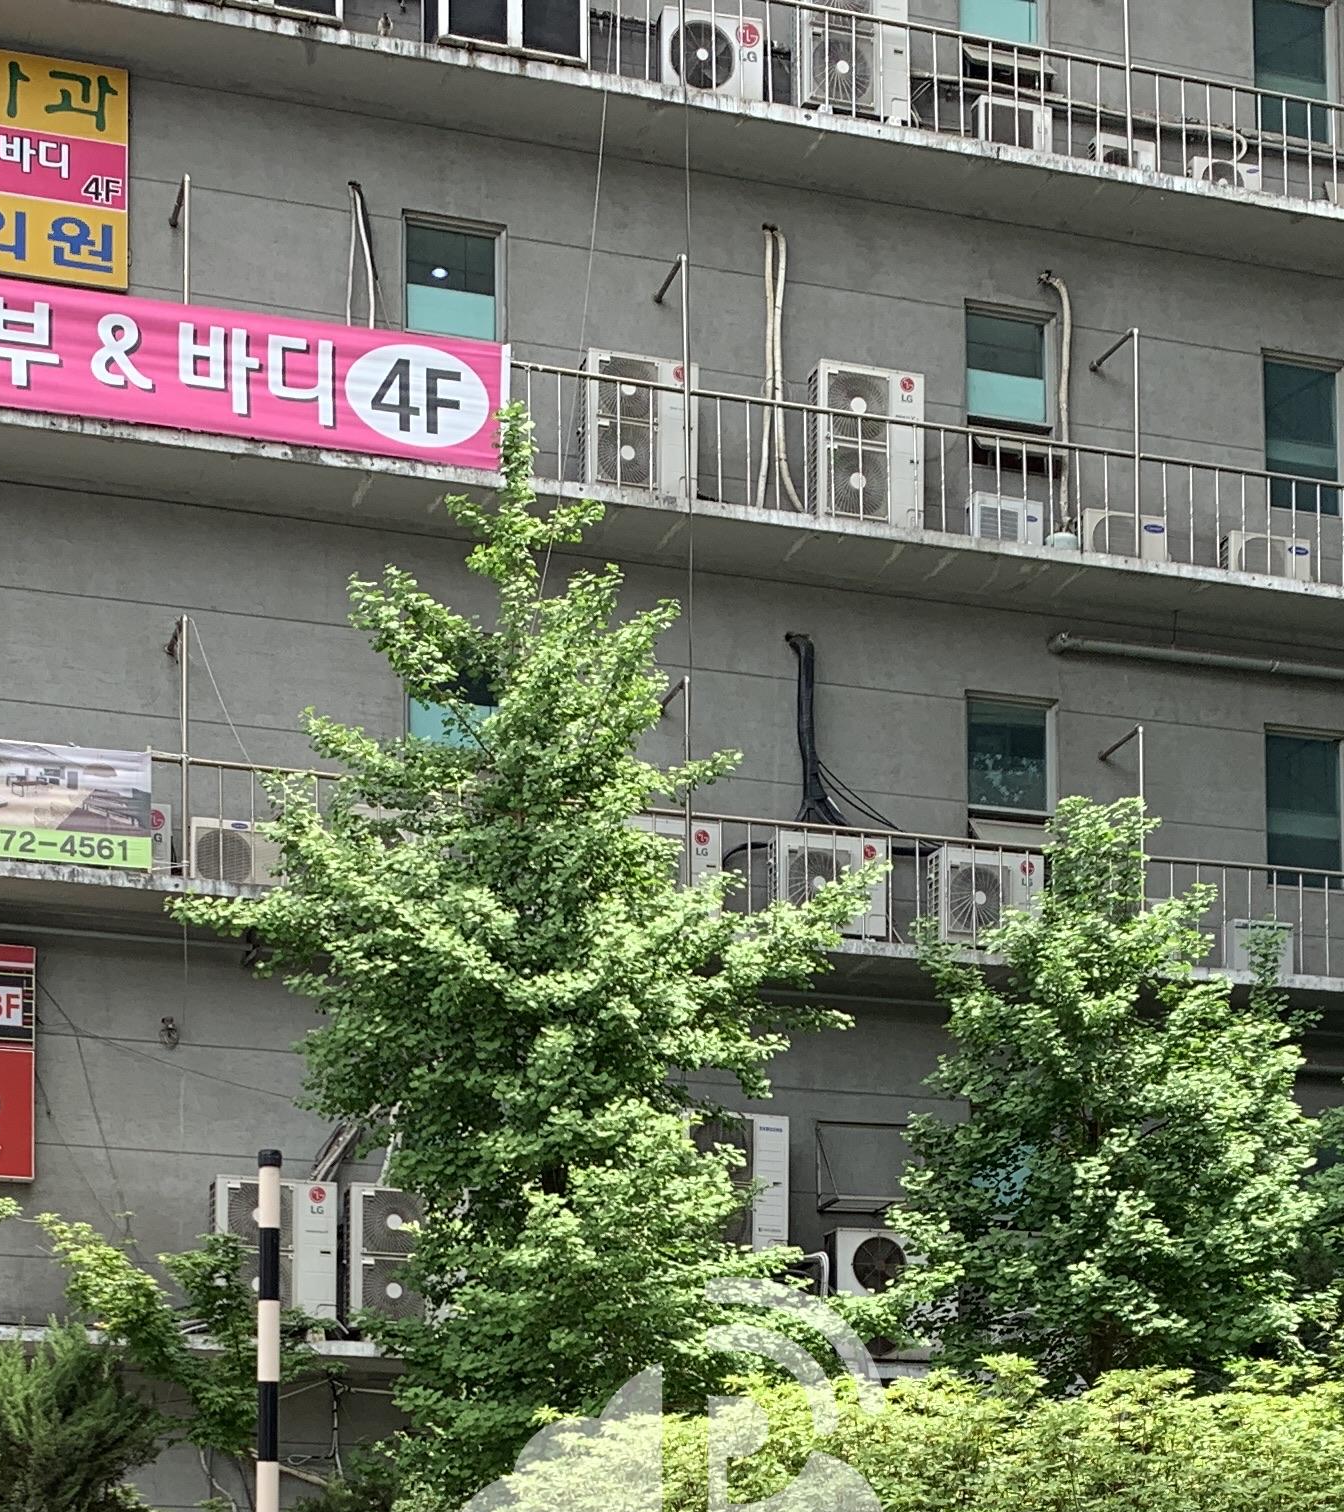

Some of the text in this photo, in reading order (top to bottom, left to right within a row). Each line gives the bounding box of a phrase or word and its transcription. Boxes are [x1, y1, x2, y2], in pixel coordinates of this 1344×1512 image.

[0, 138, 69, 178] 바디
[81, 176, 122, 204] 4F
[90, 314, 153, 390] &
[179, 327, 336, 427] 바디
[371, 358, 462, 434] 4F
[311, 1206, 324, 1214] LG
